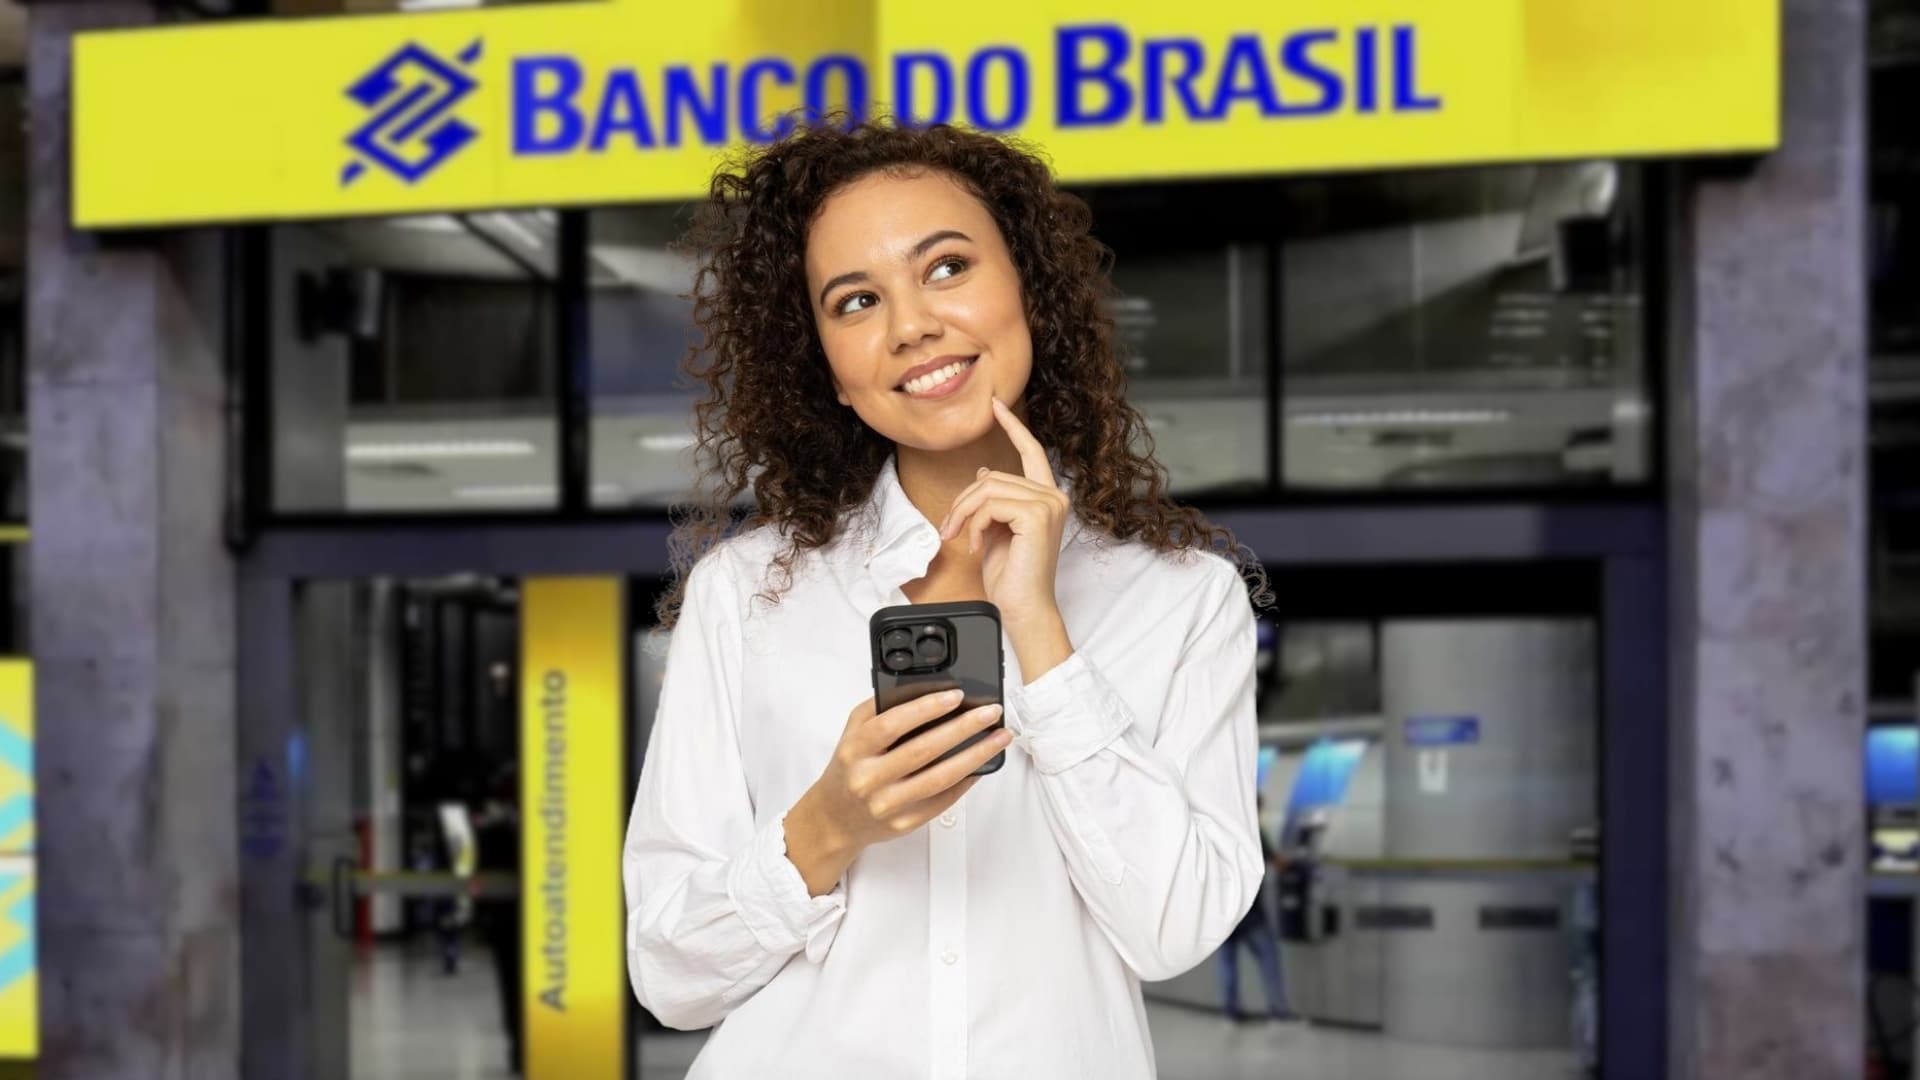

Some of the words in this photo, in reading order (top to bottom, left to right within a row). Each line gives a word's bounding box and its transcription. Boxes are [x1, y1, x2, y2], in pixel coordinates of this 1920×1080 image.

[511, 54, 869, 156] BANCO
[892, 46, 1031, 134] DO
[1055, 23, 1440, 128] BRASIL
[539, 669, 566, 1012] Autoatendimento
